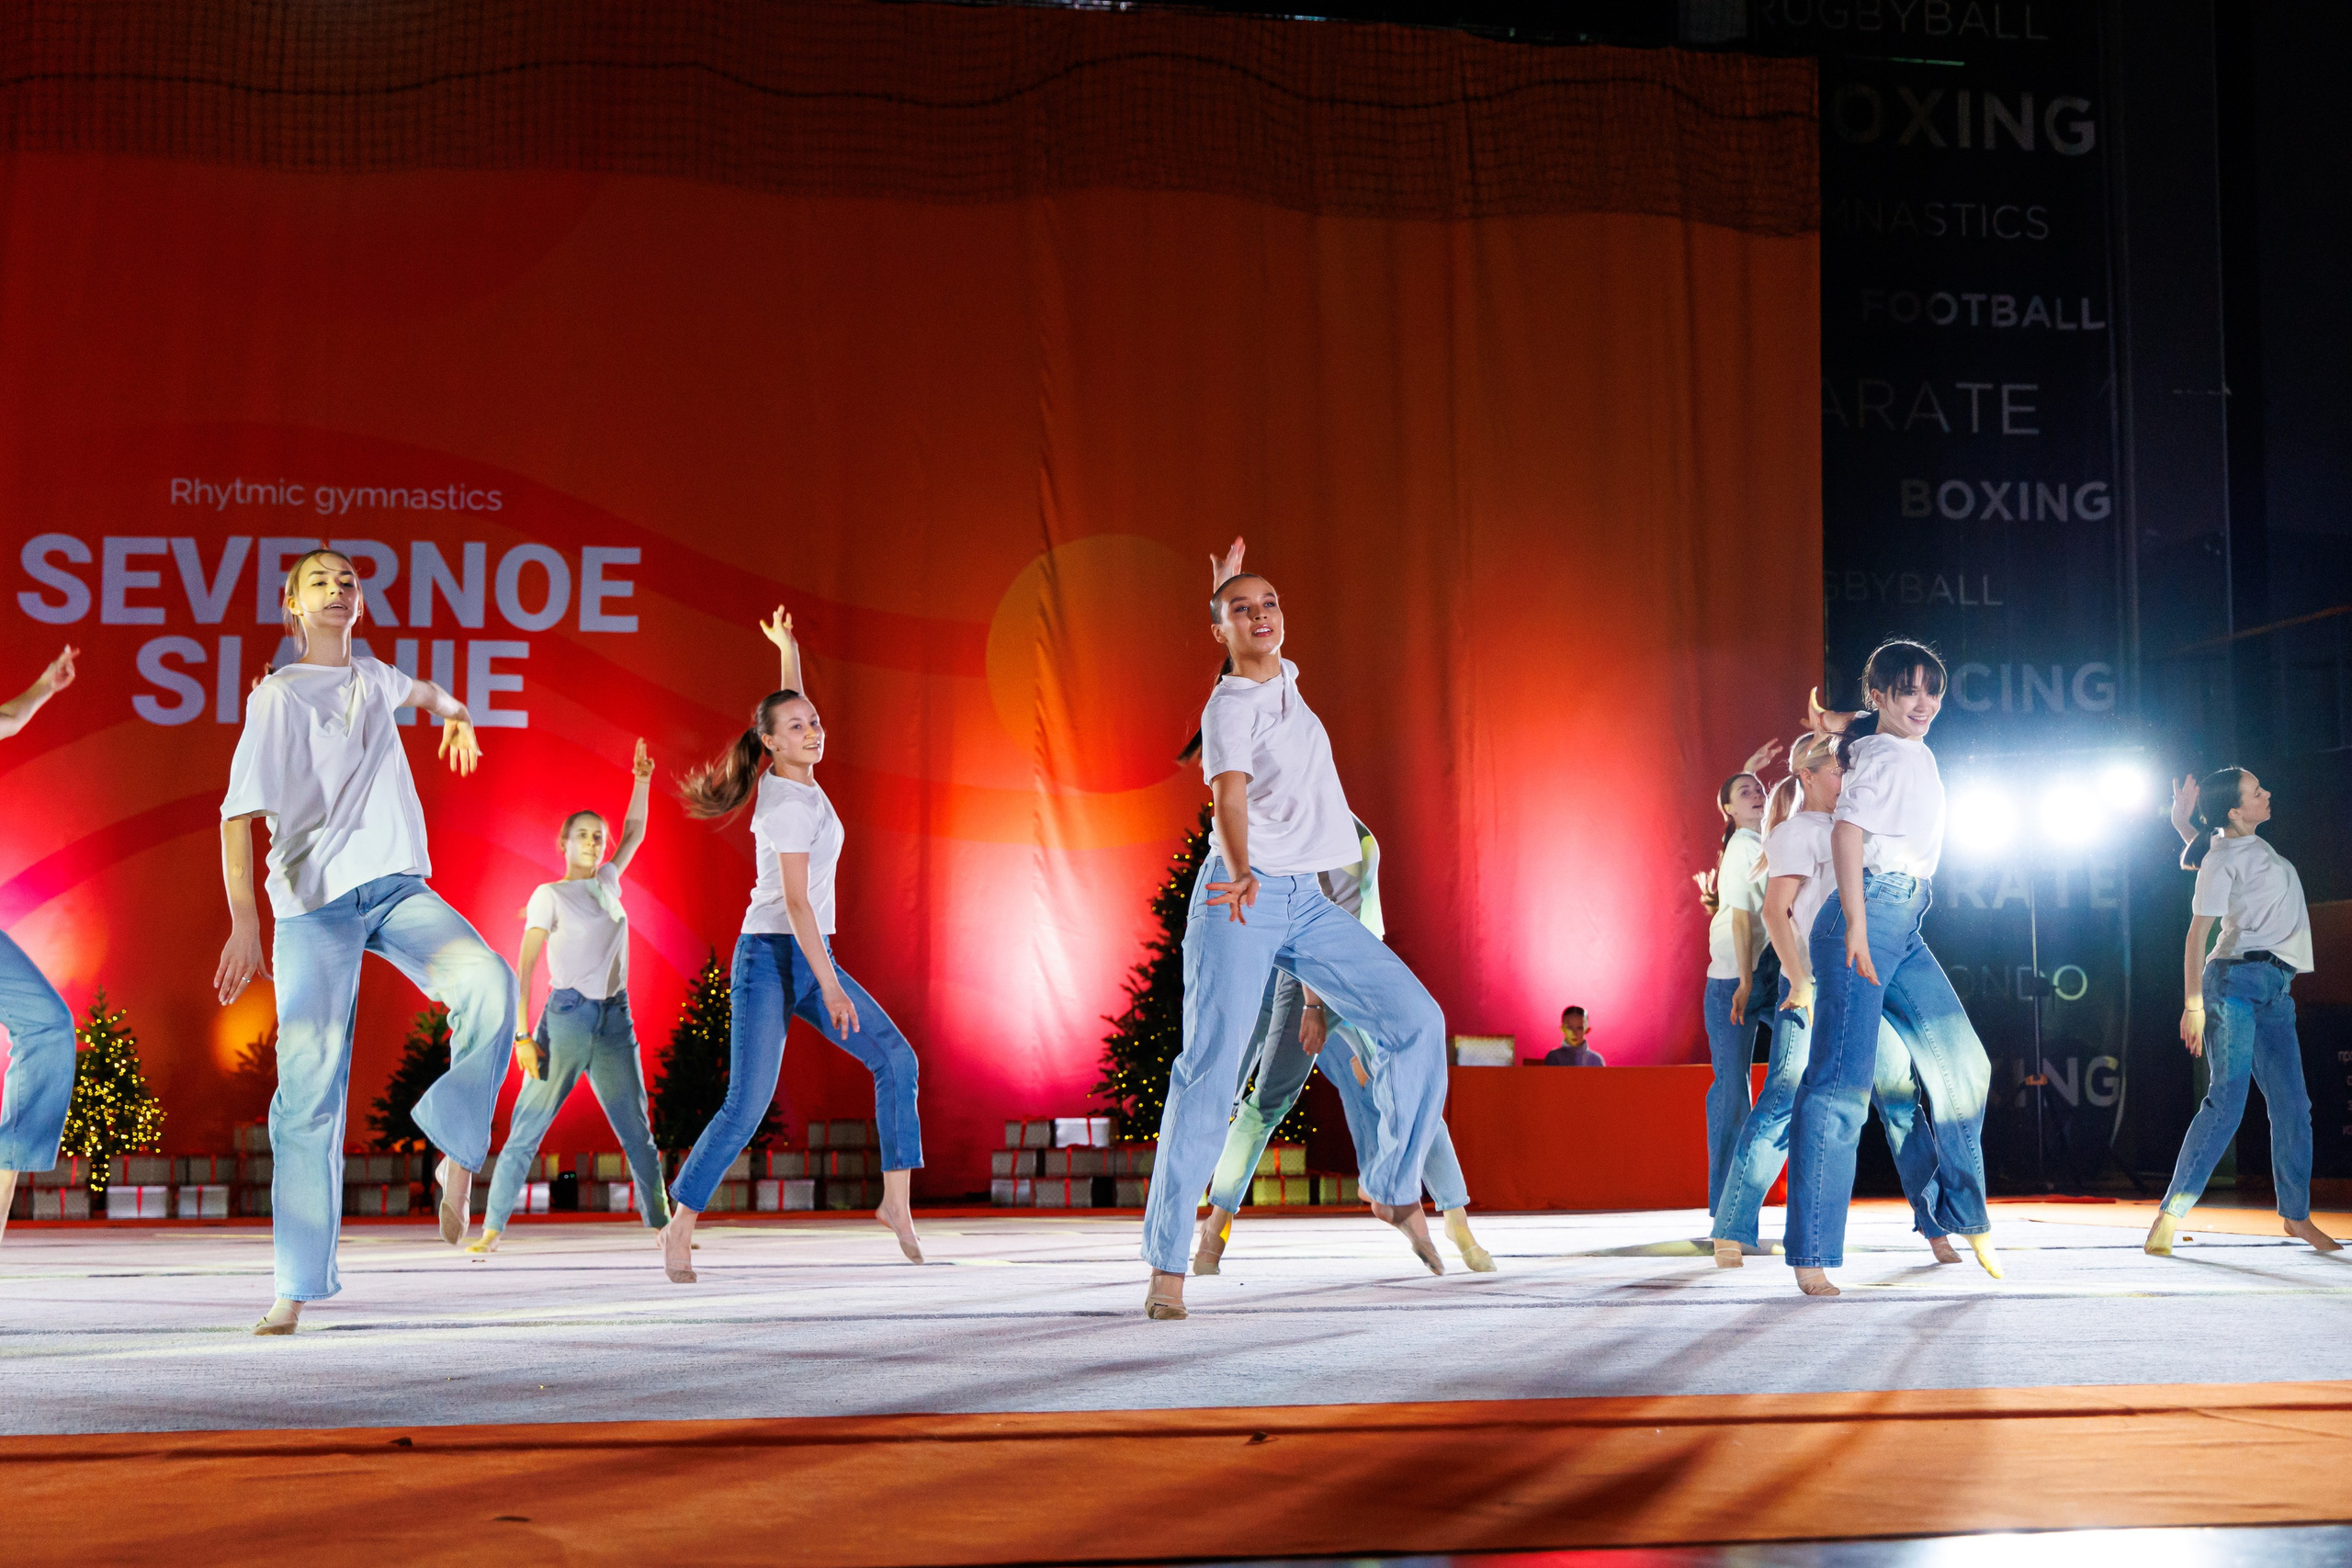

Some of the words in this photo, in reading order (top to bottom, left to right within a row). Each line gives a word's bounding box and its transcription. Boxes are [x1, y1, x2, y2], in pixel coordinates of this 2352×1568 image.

[1860, 288, 2106, 331] FOOTBALL
[170, 478, 305, 512] Rhytmic
[314, 483, 503, 515] gymnastics
[1899, 478, 2112, 523] BOXING
